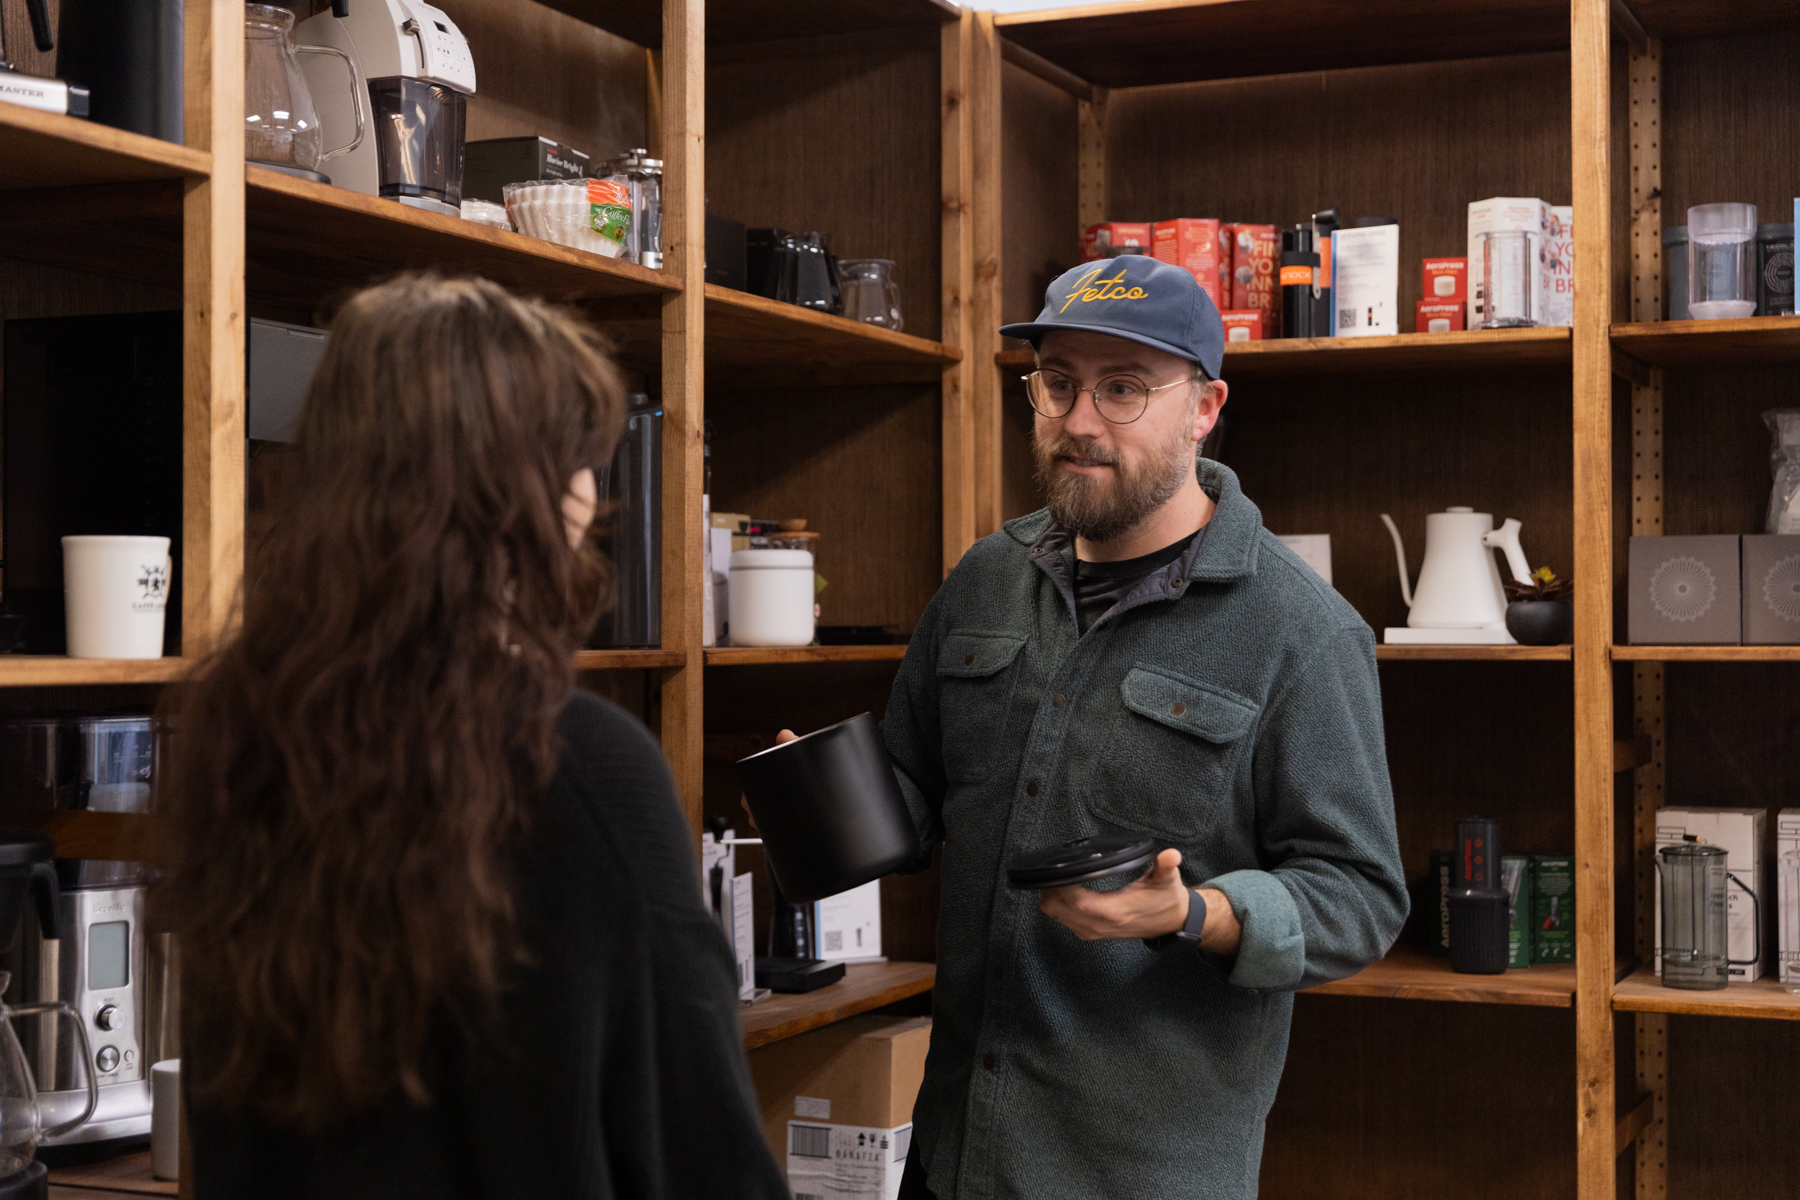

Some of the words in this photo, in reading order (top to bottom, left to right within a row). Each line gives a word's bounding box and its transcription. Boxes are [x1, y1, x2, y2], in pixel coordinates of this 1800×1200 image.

[602, 207, 625, 222] Coffee
[1425, 262, 1465, 270] AeroPress
[1060, 268, 1148, 313] Fetco
[1420, 305, 1460, 313] AeroPress
